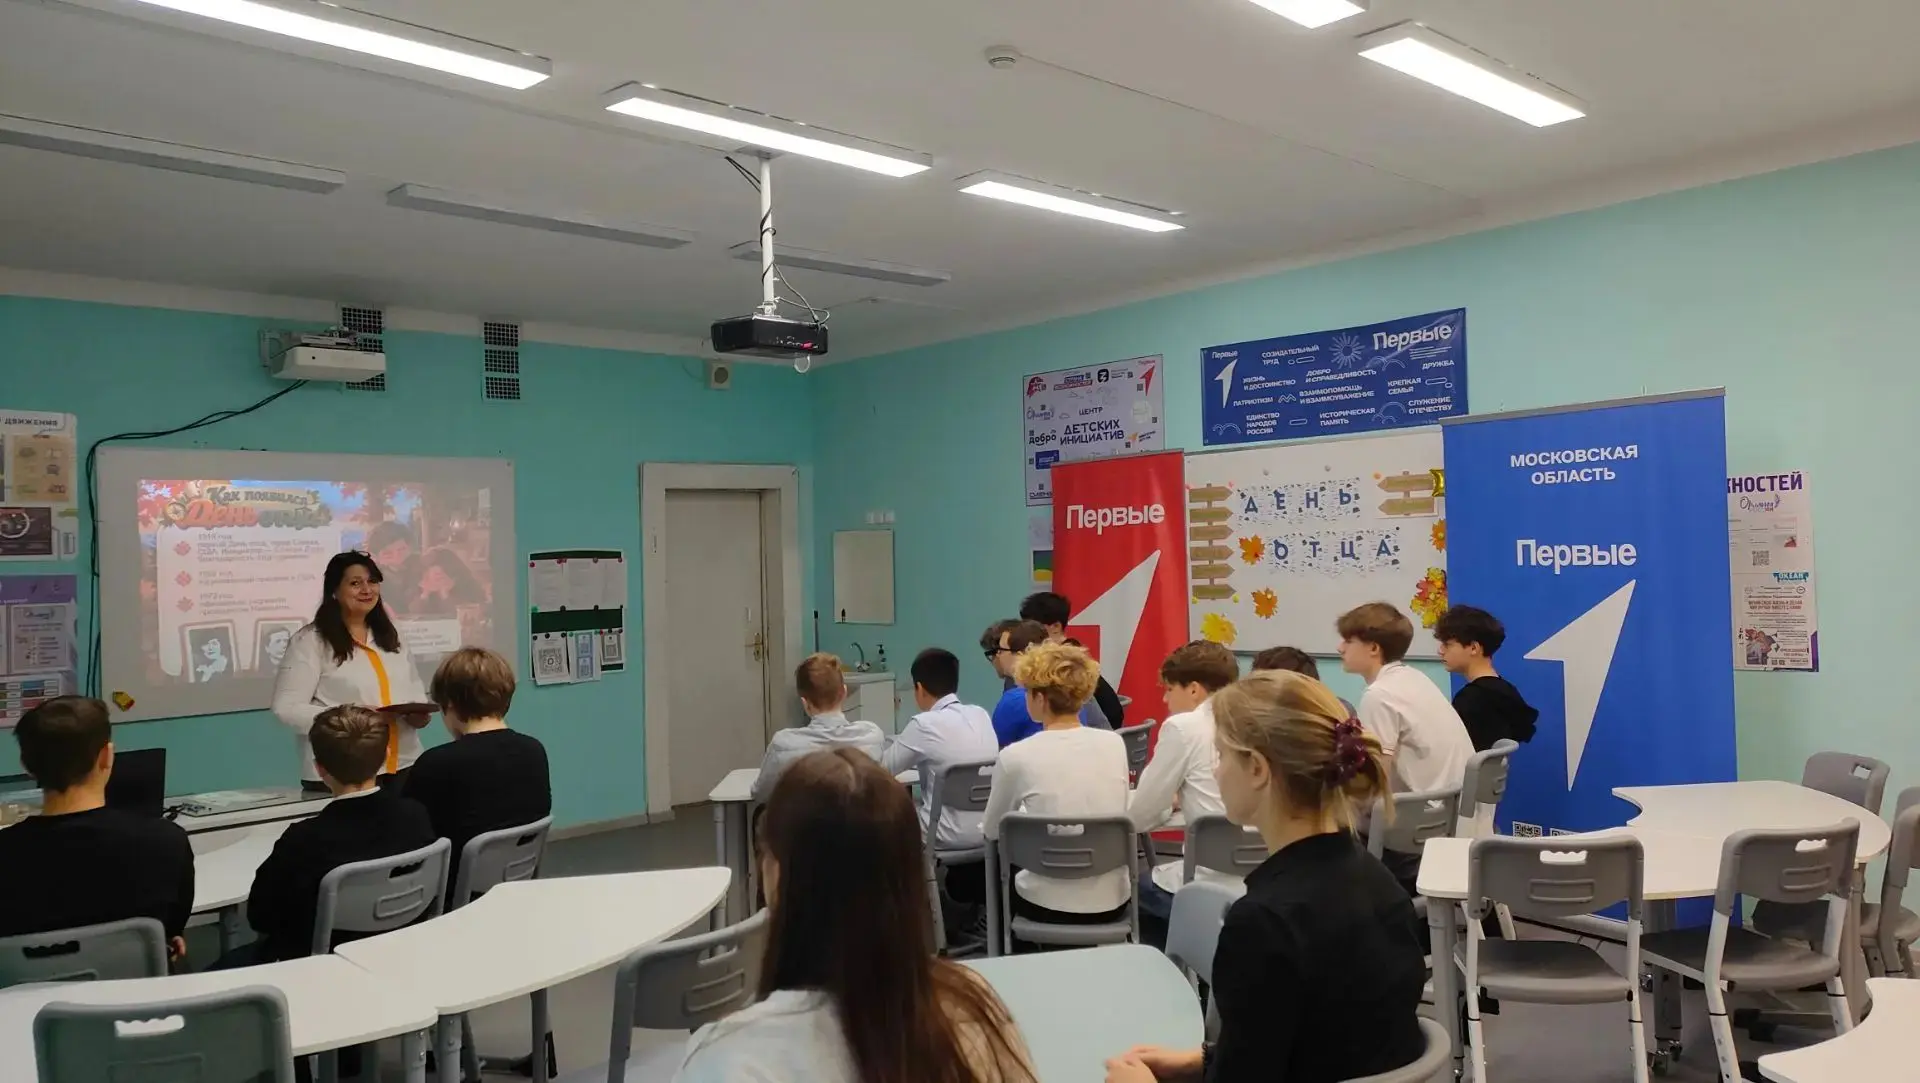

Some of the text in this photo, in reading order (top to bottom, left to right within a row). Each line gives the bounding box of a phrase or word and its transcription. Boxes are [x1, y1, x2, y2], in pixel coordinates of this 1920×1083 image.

[1373, 325, 1452, 351] Первые
[1212, 350, 1238, 359] Первые
[1262, 344, 1320, 358] СОЗИДАТЕЛЬНЫЙ
[1422, 359, 1455, 370] ДРУЖБА
[1306, 368, 1331, 377] ДОБРО
[1312, 369, 1377, 383] СПРАВЕДЛИВОСТЬ
[1243, 376, 1265, 384] ЖИЗНЬ
[1249, 379, 1296, 390] ДОСТОИНСТВО
[1388, 378, 1421, 387] КРЕПКАЯ
[1299, 384, 1363, 397] ВЗАИМОПОМОЩЬ
[1388, 387, 1414, 395] СЕМЬЯ
[1233, 397, 1273, 406] ПАТРИОТИЗМ
[1306, 390, 1375, 404] ВЗАИМОУВАЖЕНИЕ
[1408, 397, 1451, 406] СЛУЖЕНИЕ
[1079, 407, 1103, 416] ЦЕНТР
[1320, 407, 1375, 418] ИСТОРИЧЕСКАЯ
[1409, 405, 1453, 415] ОТЕЧЕСТВУ
[1246, 412, 1280, 421] ЕДИНСТВО
[1320, 418, 1349, 426] ПАМЯТЬ
[1064, 419, 1120, 435] ДЕТСКИХ
[1246, 420, 1277, 428] НАРОДОВ
[1060, 430, 1124, 446] ИНИЦИАТИВ
[1510, 445, 1638, 467] МОСКОВСКАЯ
[1531, 467, 1616, 485] ОБЛАСТЬ
[207, 486, 240, 504] Как
[1244, 489, 1352, 514] ДЕНЬ
[1066, 503, 1165, 535] Первые
[1274, 539, 1392, 560] ОТЦА
[1516, 539, 1637, 574] Первые
